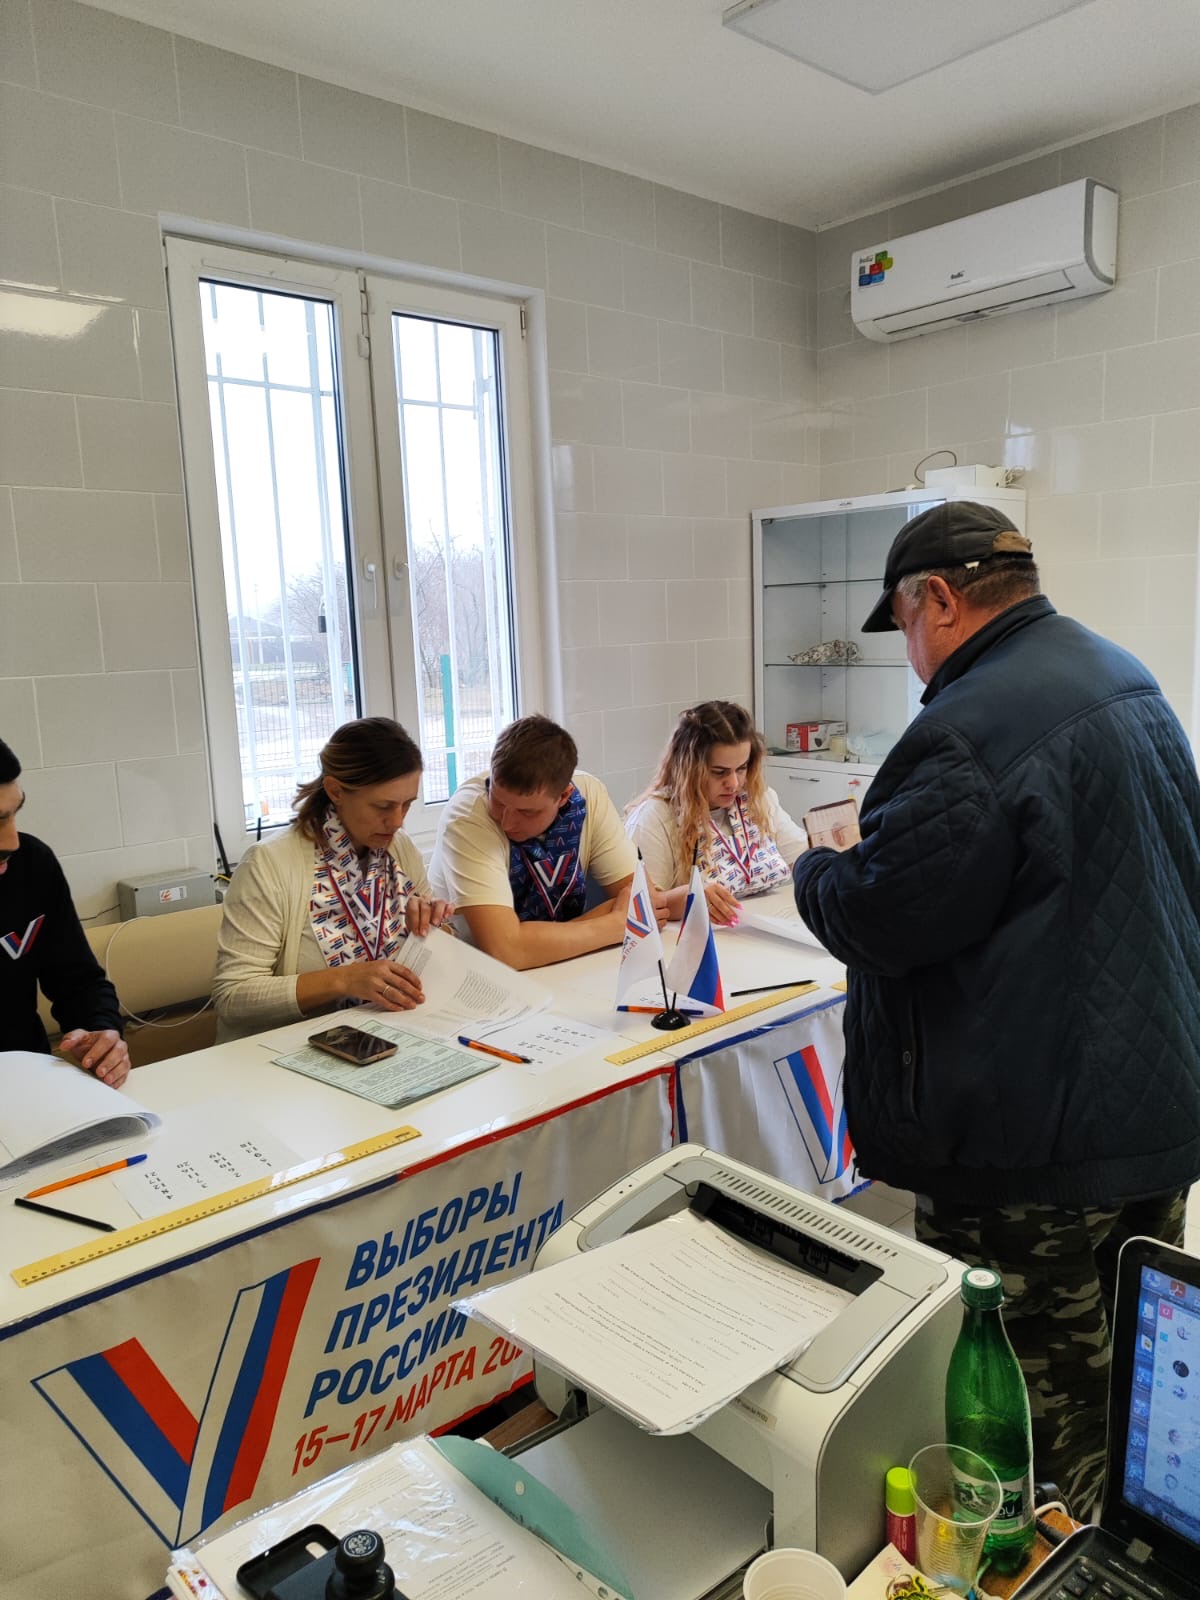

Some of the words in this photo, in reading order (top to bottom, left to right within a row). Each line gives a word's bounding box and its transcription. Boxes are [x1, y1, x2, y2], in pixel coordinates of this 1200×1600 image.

[324, 1199, 564, 1354] ПРЕЗИДЕНТА
[345, 1171, 522, 1291] ВЫБОРЫ
[303, 1306, 468, 1419] РОССИИ
[384, 1346, 477, 1431] МАРТА
